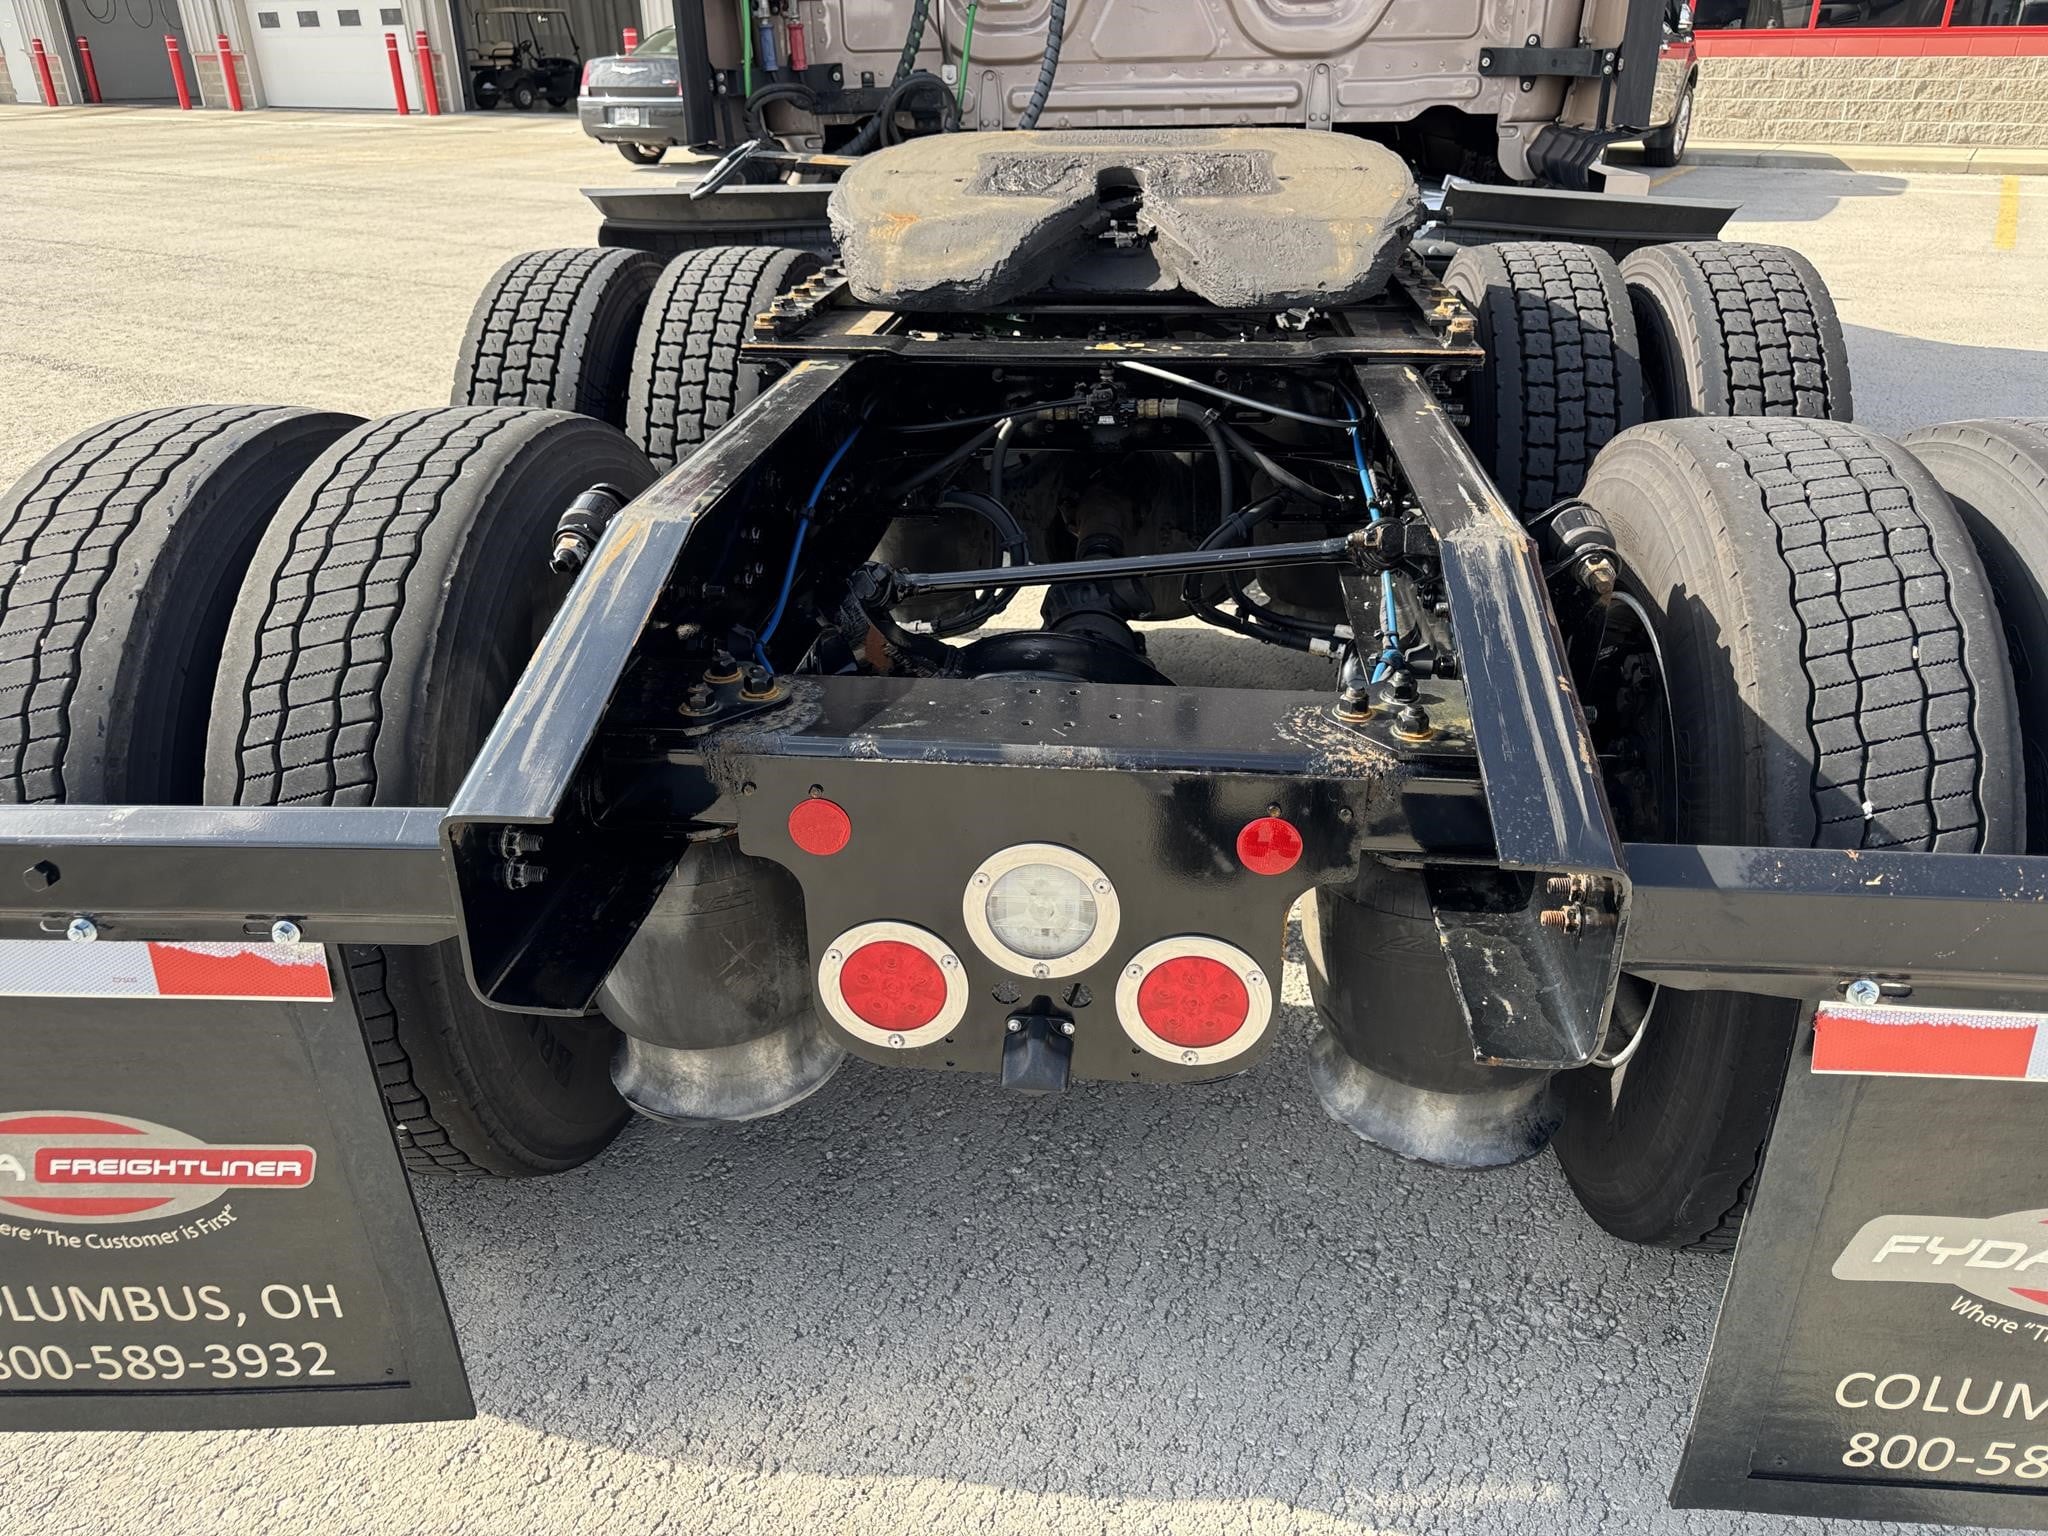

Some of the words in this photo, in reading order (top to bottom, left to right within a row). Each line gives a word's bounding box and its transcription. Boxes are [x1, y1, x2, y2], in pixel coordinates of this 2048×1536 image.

[49, 1158, 302, 1178] FREIGHTLINER
[85, 1228, 180, 1250] Customer
[180, 1224, 199, 1240] is
[0, 1285, 247, 1328] LUMBUS,
[260, 1283, 344, 1319] OH
[1950, 1295, 2019, 1334] Where
[1841, 1431, 2048, 1479] 800-58
